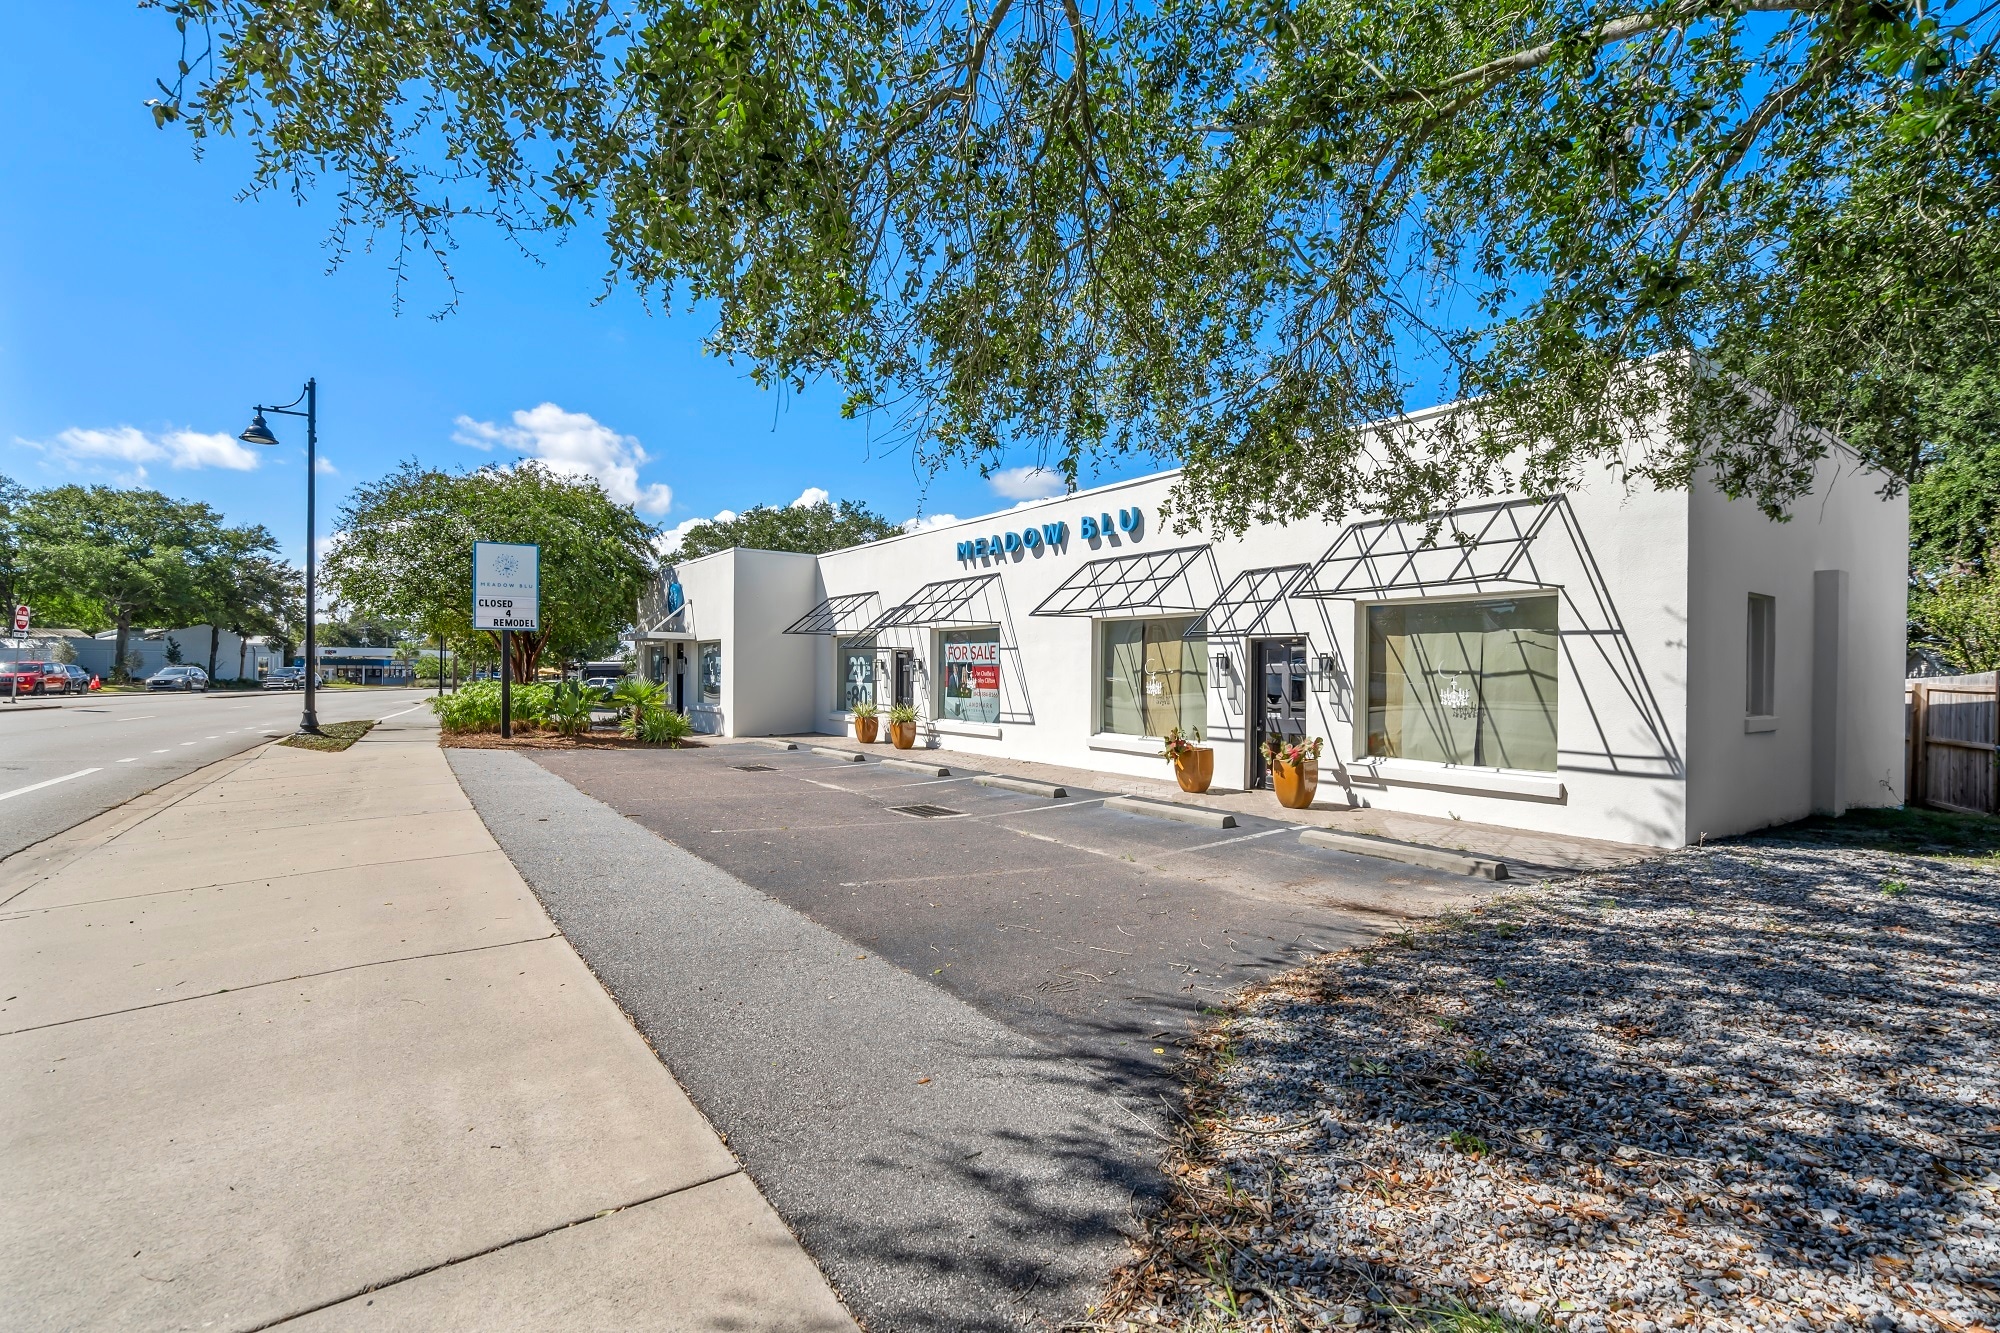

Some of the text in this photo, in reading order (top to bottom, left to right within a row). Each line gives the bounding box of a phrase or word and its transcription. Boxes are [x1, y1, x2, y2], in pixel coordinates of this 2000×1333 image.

[957, 506, 1140, 561] MEADOW BLU
[478, 599, 513, 608] CLOSED
[505, 609, 511, 617] 4
[493, 618, 535, 627] REMODEL
[948, 645, 996, 660] FOR SALE
[848, 656, 866, 680] 20
